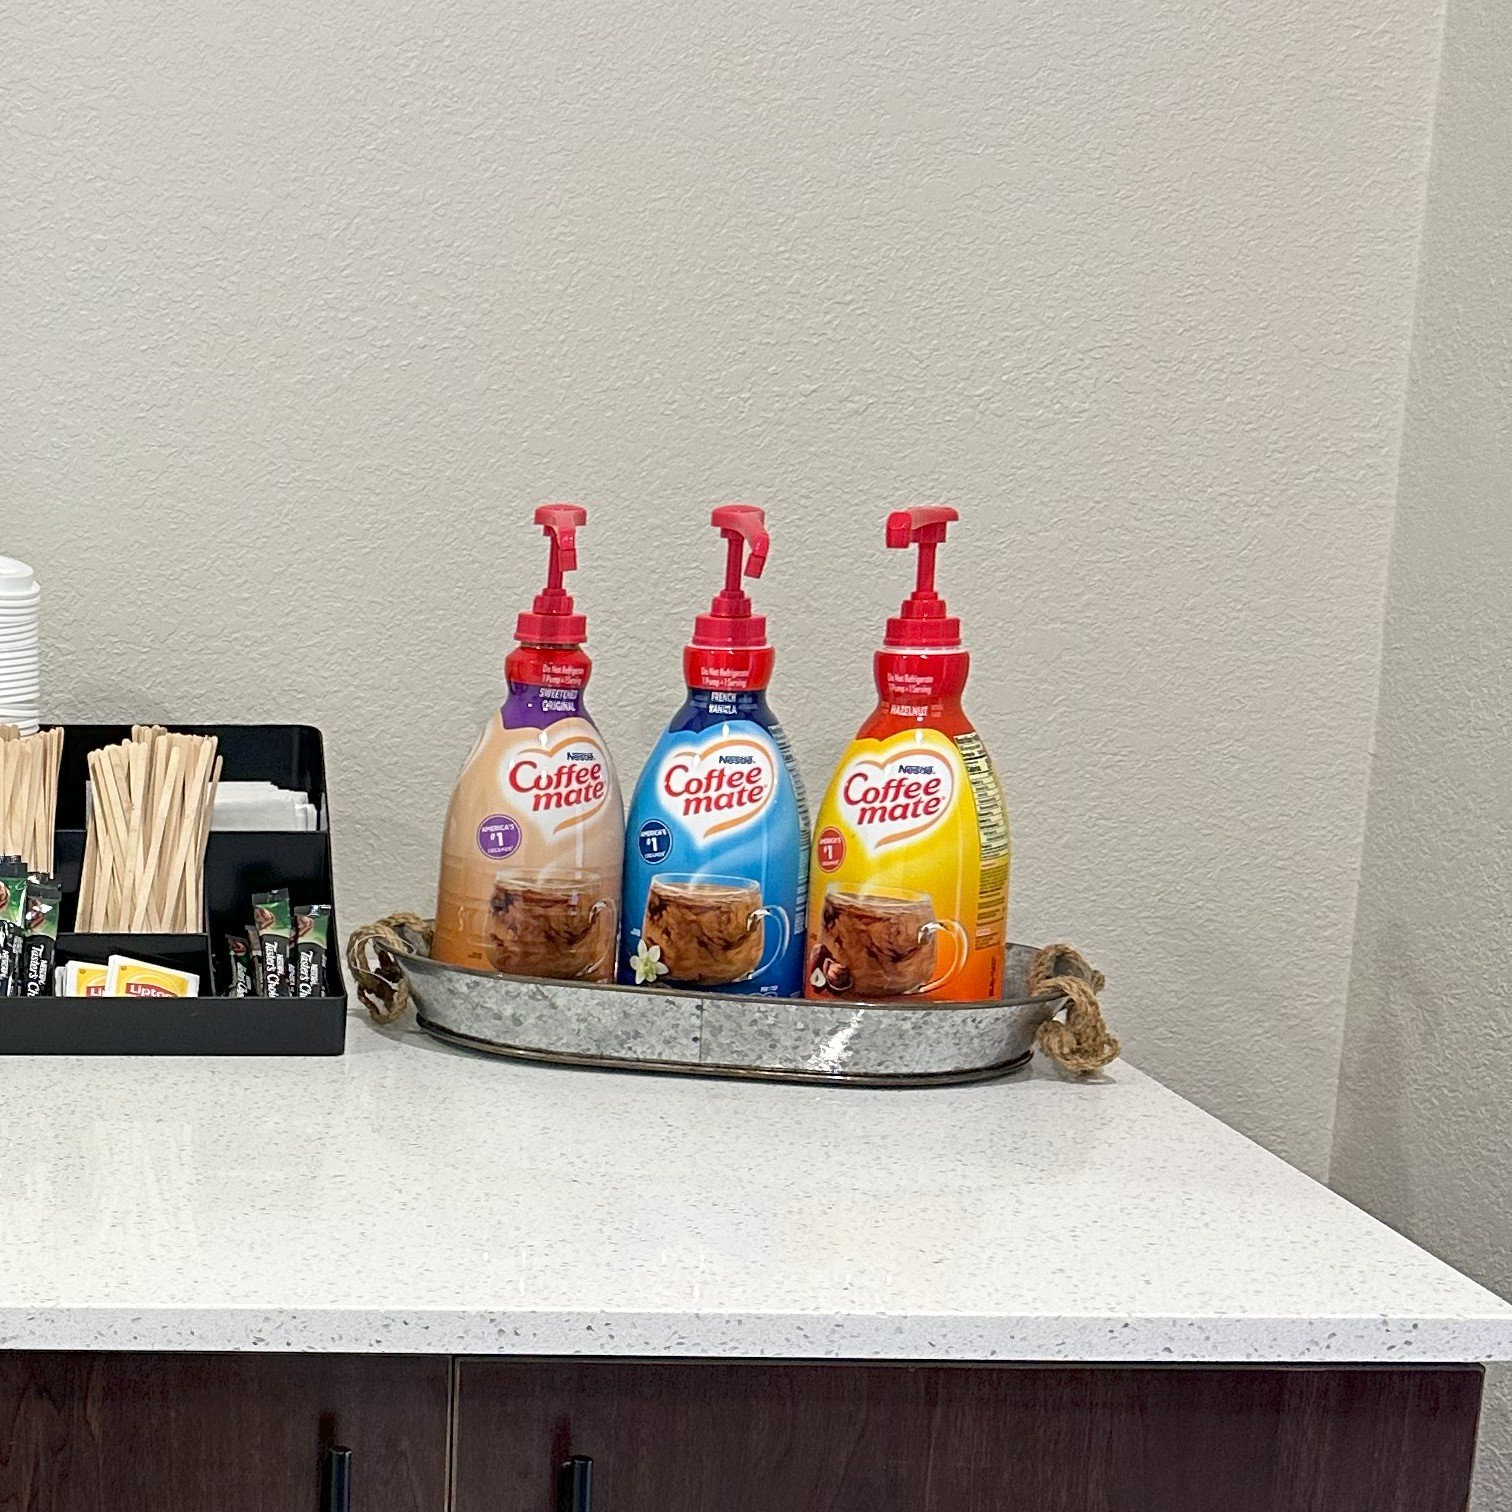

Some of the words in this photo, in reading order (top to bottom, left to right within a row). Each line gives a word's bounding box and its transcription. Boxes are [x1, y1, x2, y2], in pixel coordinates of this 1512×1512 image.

[509, 760, 602, 793] Coffee
[664, 764, 763, 797] Coffee
[843, 772, 942, 806] Coffee
[531, 781, 605, 812] mate
[682, 784, 765, 816] mate
[857, 796, 941, 825] mate
[129, 984, 177, 997] Lipto
